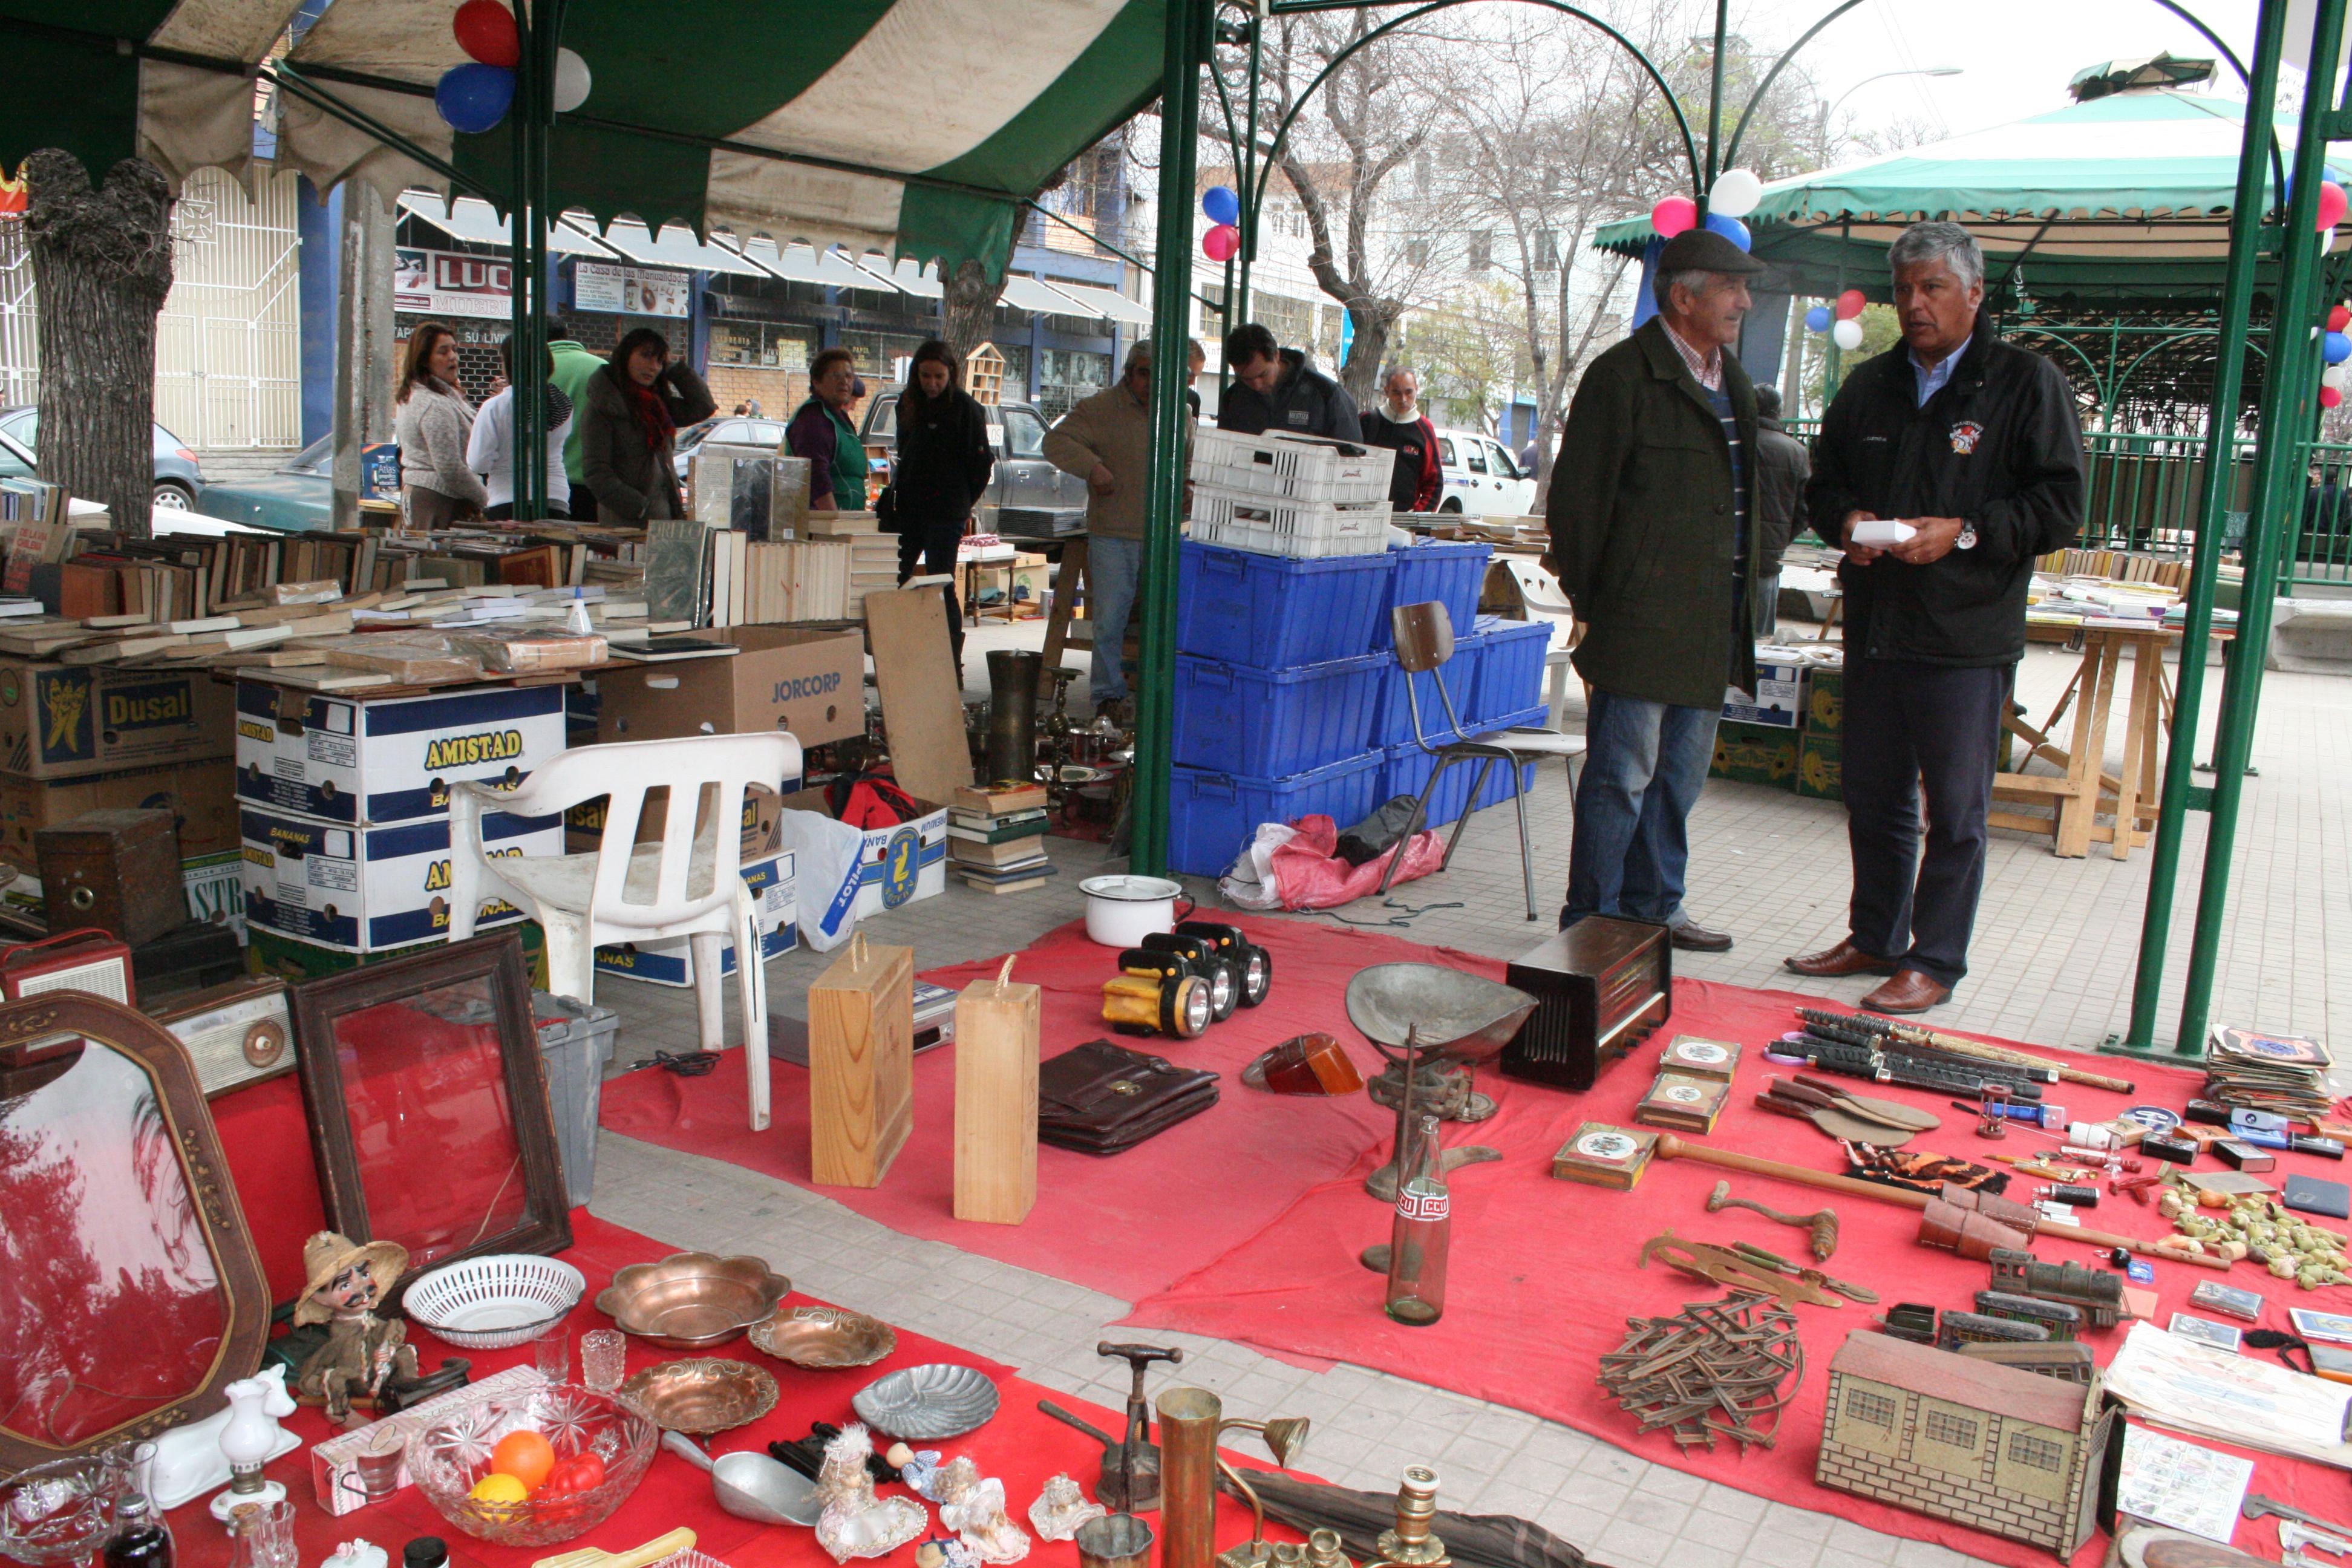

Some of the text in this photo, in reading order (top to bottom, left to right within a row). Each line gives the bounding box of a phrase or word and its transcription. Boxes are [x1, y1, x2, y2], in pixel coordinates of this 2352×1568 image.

[578, 263, 690, 284] La Casa de las Manualidades
[465, 332, 479, 343] SU
[772, 671, 841, 703] JORCORP
[109, 688, 188, 725] Dusal
[238, 719, 274, 743] AMISTAD
[425, 730, 522, 771] AMISTAD
[270, 827, 310, 844] BANANAS
[837, 863, 863, 908] PILOT
[1425, 1201, 1446, 1212] CCU
